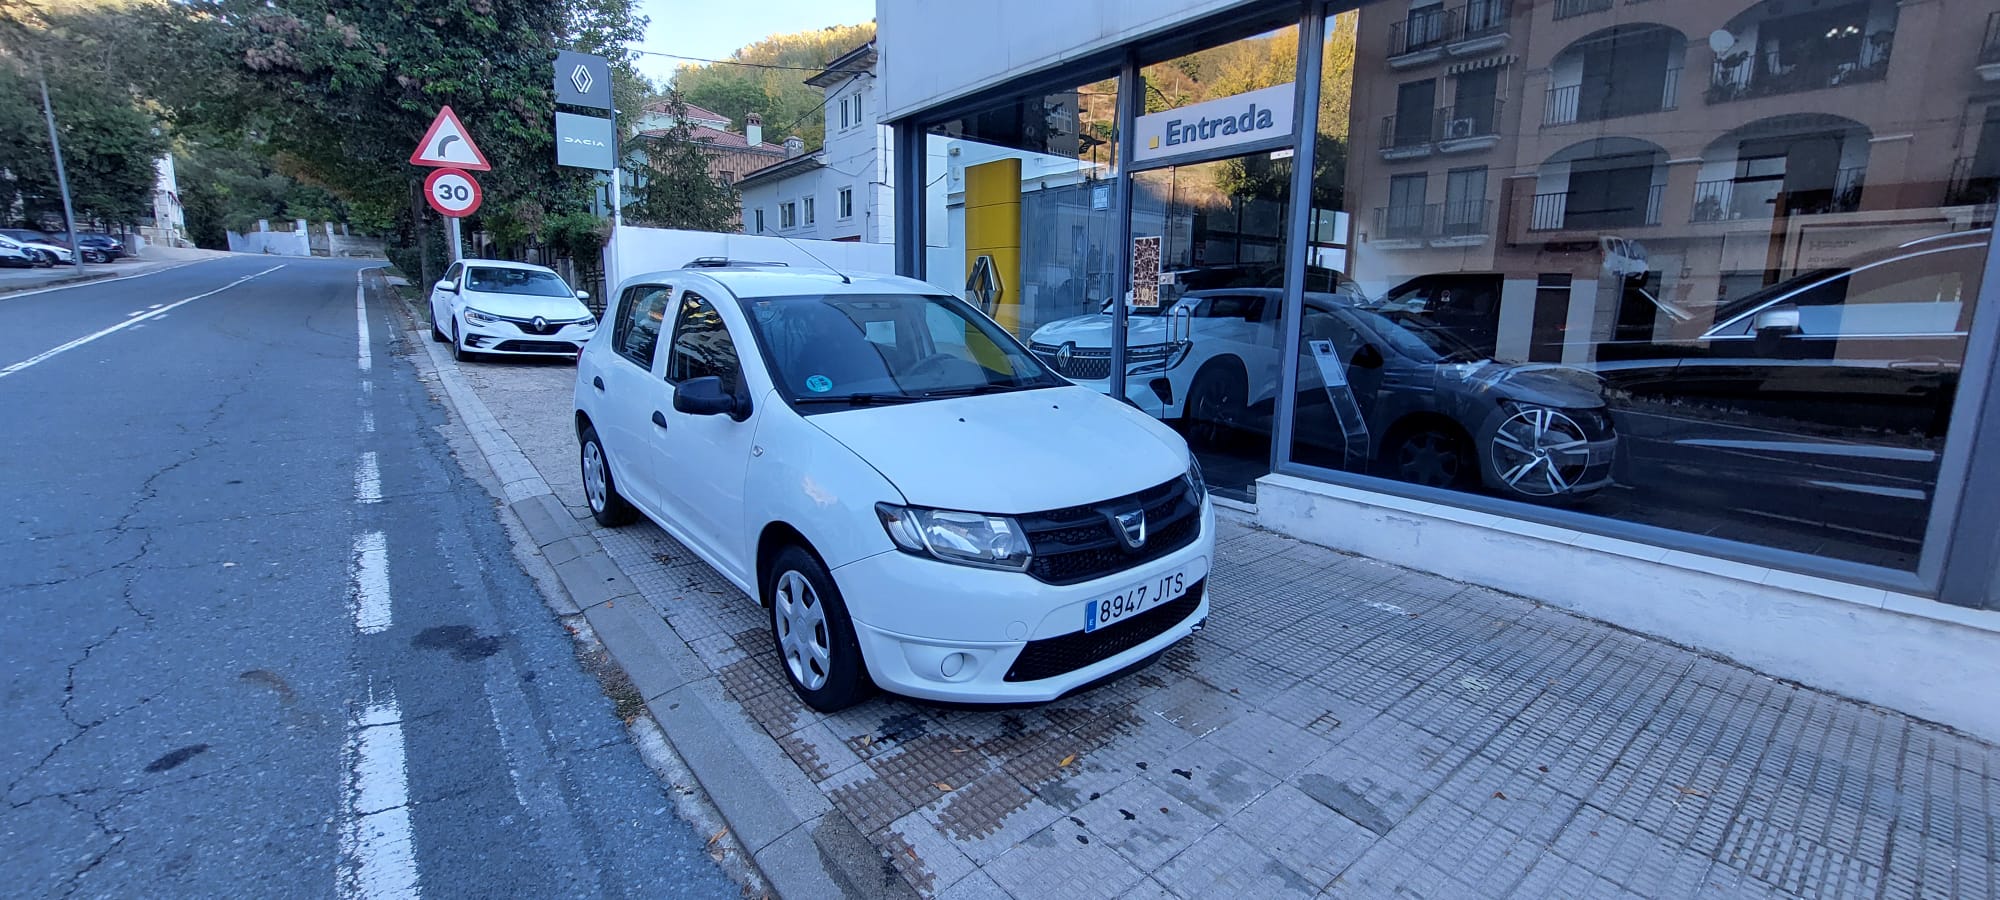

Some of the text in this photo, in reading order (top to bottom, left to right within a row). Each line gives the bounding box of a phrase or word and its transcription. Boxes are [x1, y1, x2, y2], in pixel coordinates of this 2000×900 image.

[1166, 103, 1274, 146] Entrada
[564, 136, 604, 148] DACIA
[438, 184, 468, 201] 30
[1100, 572, 1184, 623] 8947 JTS
